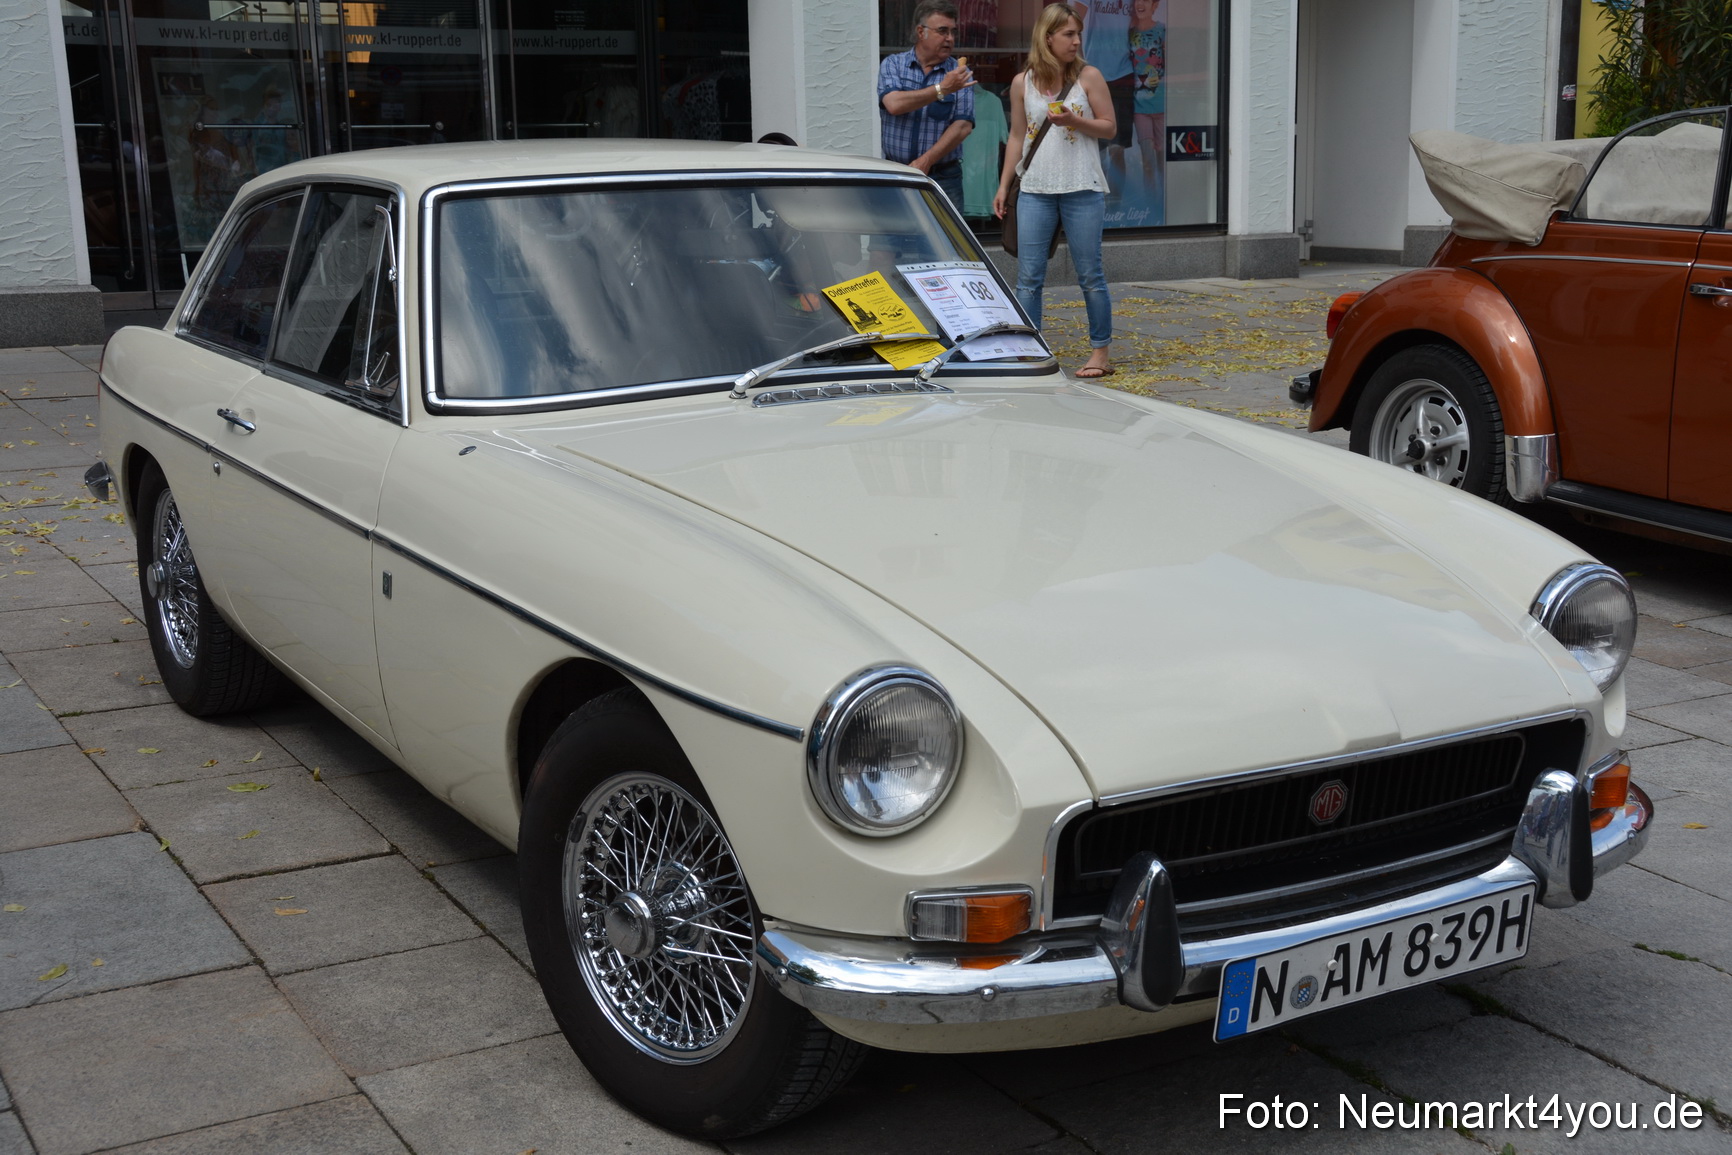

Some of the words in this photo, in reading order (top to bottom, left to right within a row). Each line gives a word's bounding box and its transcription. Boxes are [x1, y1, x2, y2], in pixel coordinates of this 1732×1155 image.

[158, 25, 289, 43] www.kl-ruppert.de
[345, 32, 462, 48] www.kl-ruppert.de
[512, 35, 619, 51] www.kl-ruppert.de
[1171, 131, 1215, 153] K&L
[827, 277, 880, 299] Oldtimertreffen
[961, 281, 995, 301] 198
[1316, 789, 1342, 817] MG
[1251, 960, 1290, 1023] N
[1321, 932, 1393, 1002] AM
[1403, 893, 1530, 978] 839H
[1228, 1007, 1240, 1024] D
